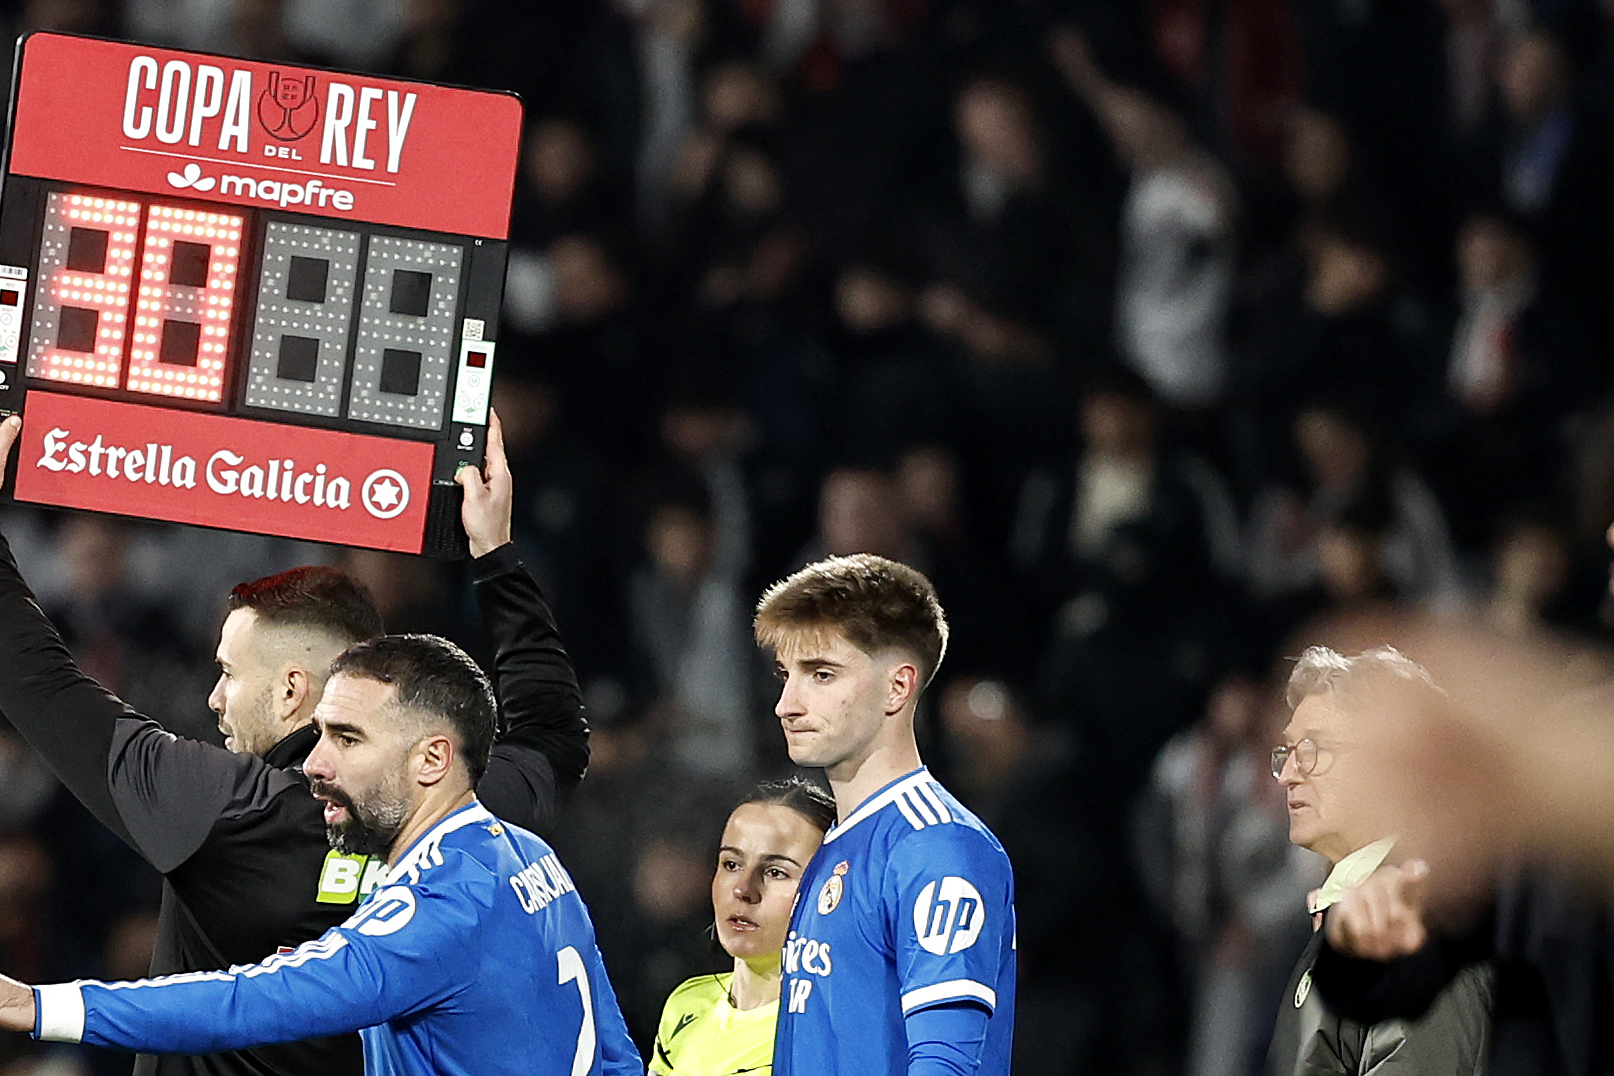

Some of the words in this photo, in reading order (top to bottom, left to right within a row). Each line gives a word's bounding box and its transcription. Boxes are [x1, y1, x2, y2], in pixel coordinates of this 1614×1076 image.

[122, 55, 252, 153] COPA
[264, 144, 303, 161] DEL
[319, 82, 418, 174] REY
[219, 173, 355, 211] mapfre
[41, 189, 244, 403] 30
[36, 426, 197, 490] Estrella
[205, 449, 352, 511] Galicia
[919, 878, 982, 955] hp
